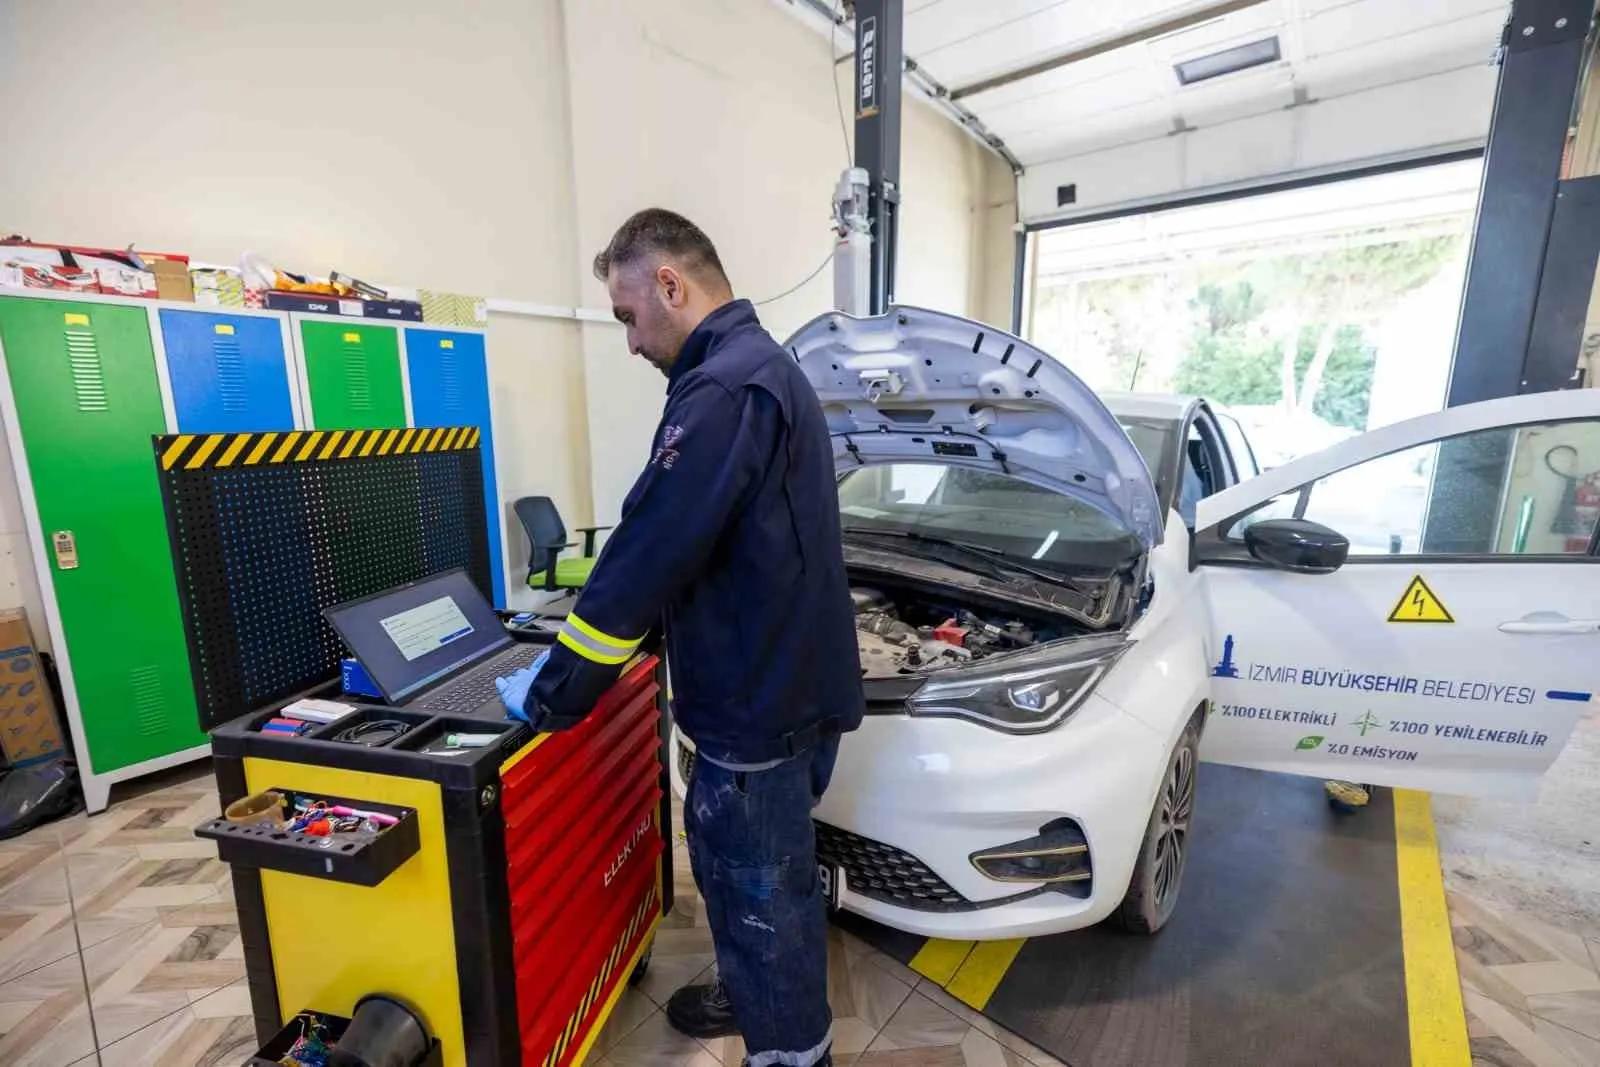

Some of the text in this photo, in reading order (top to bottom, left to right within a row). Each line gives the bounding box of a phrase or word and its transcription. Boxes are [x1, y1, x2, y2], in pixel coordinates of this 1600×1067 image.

[1221, 704, 1337, 726] %100 ELEKTRİKLİ
[1389, 720, 1549, 747] %100 YENİLENEBİLİR
[1328, 743, 1418, 761] %0 EMİSYON
